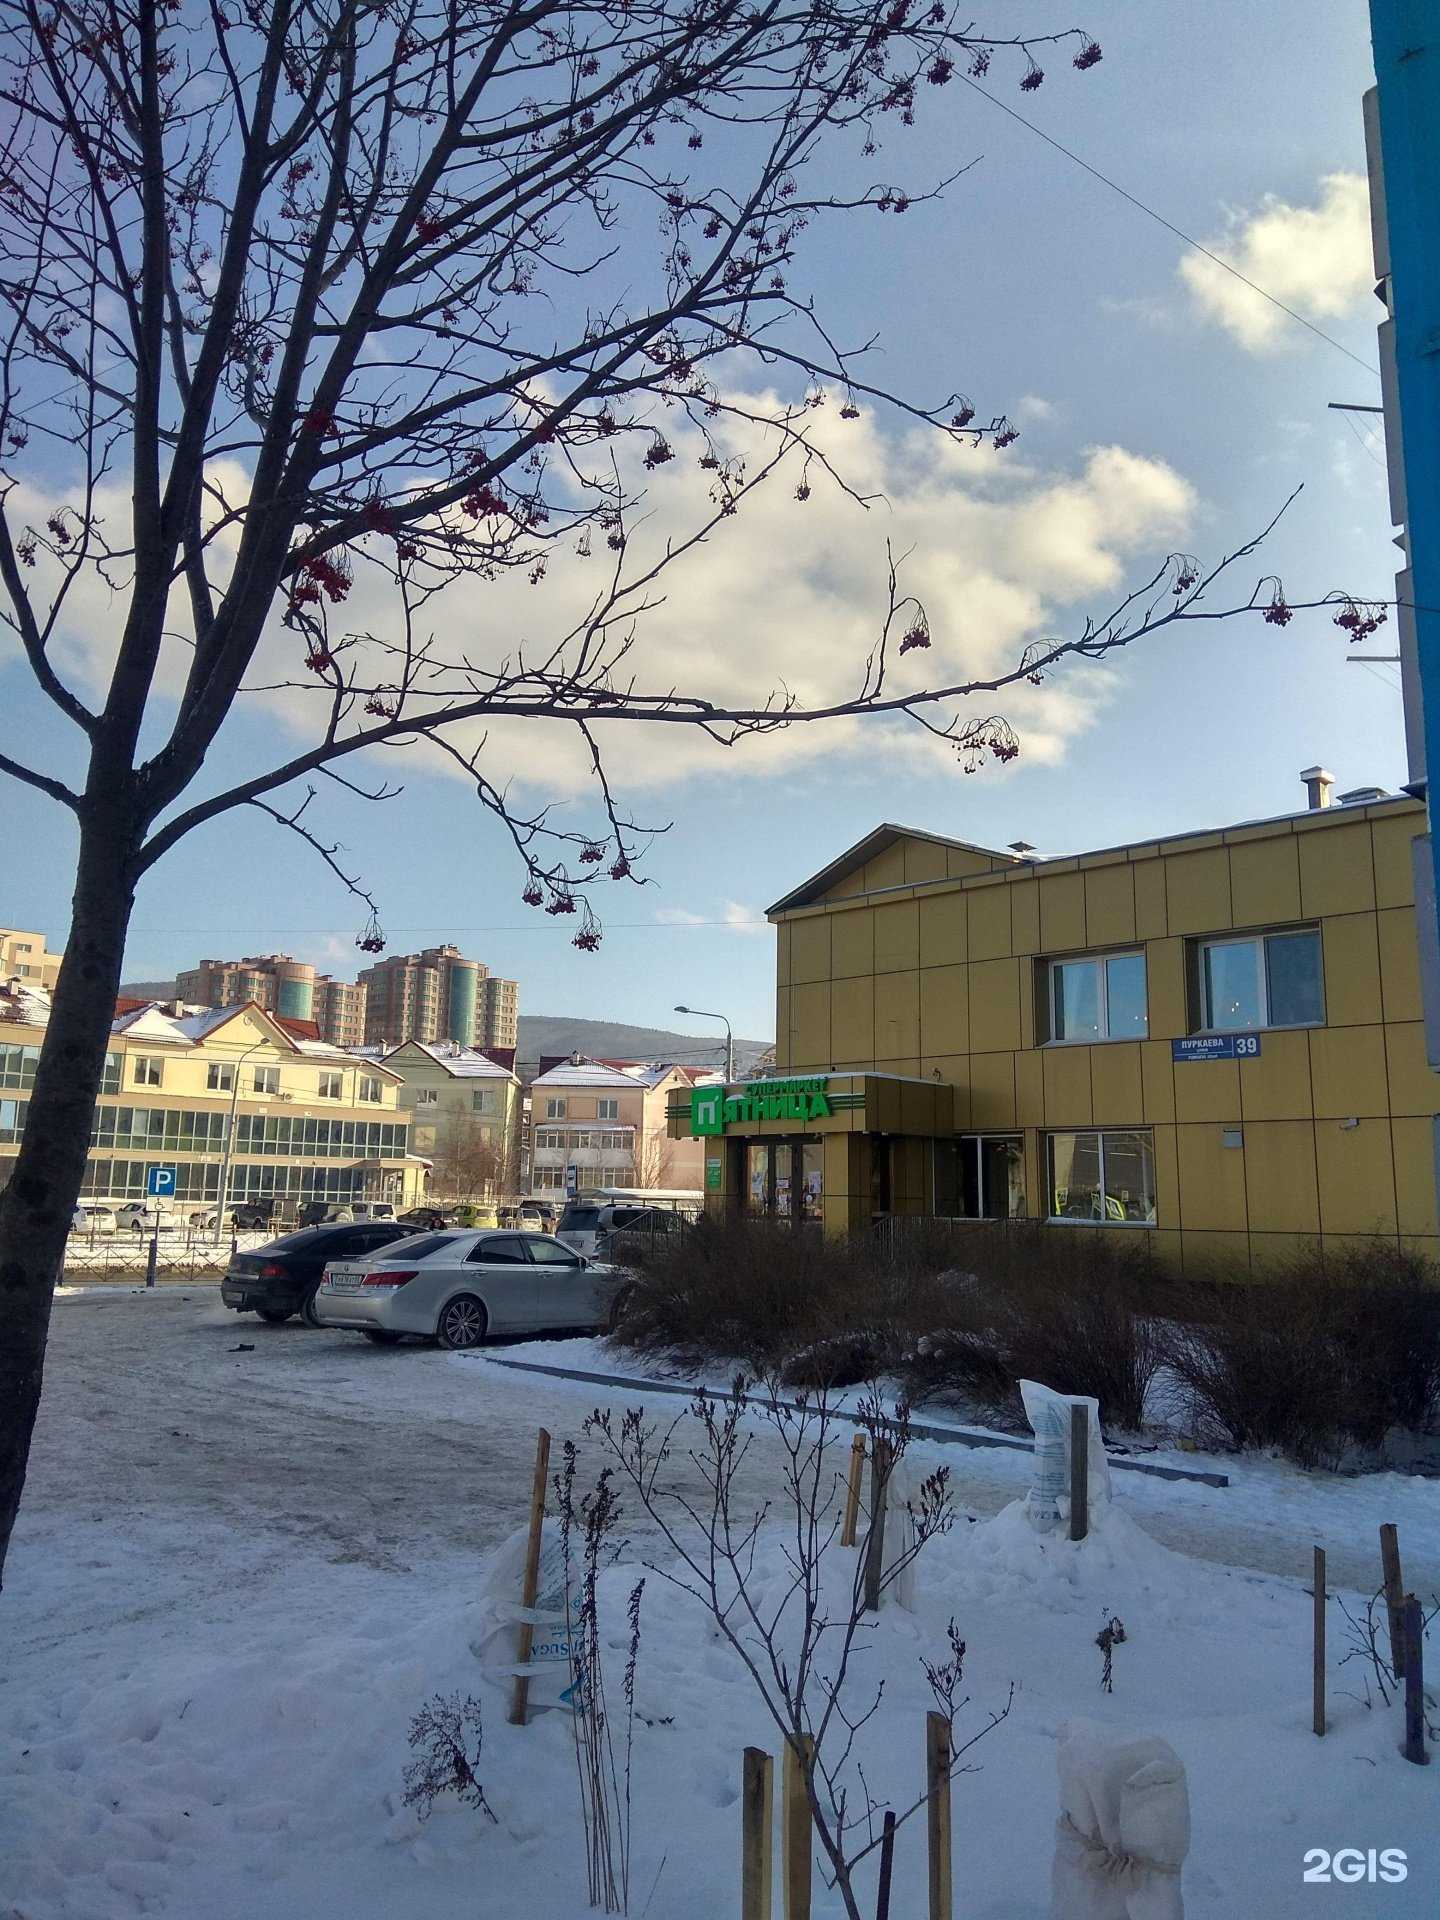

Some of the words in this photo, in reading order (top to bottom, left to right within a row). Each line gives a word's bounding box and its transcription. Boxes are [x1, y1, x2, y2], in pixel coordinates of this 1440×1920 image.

[1182, 1038, 1224, 1049] ПУРКАЕВА
[1236, 1037, 1257, 1054] 39
[156, 1171, 172, 1193] P
[528, 1643, 569, 1657] SUGA
